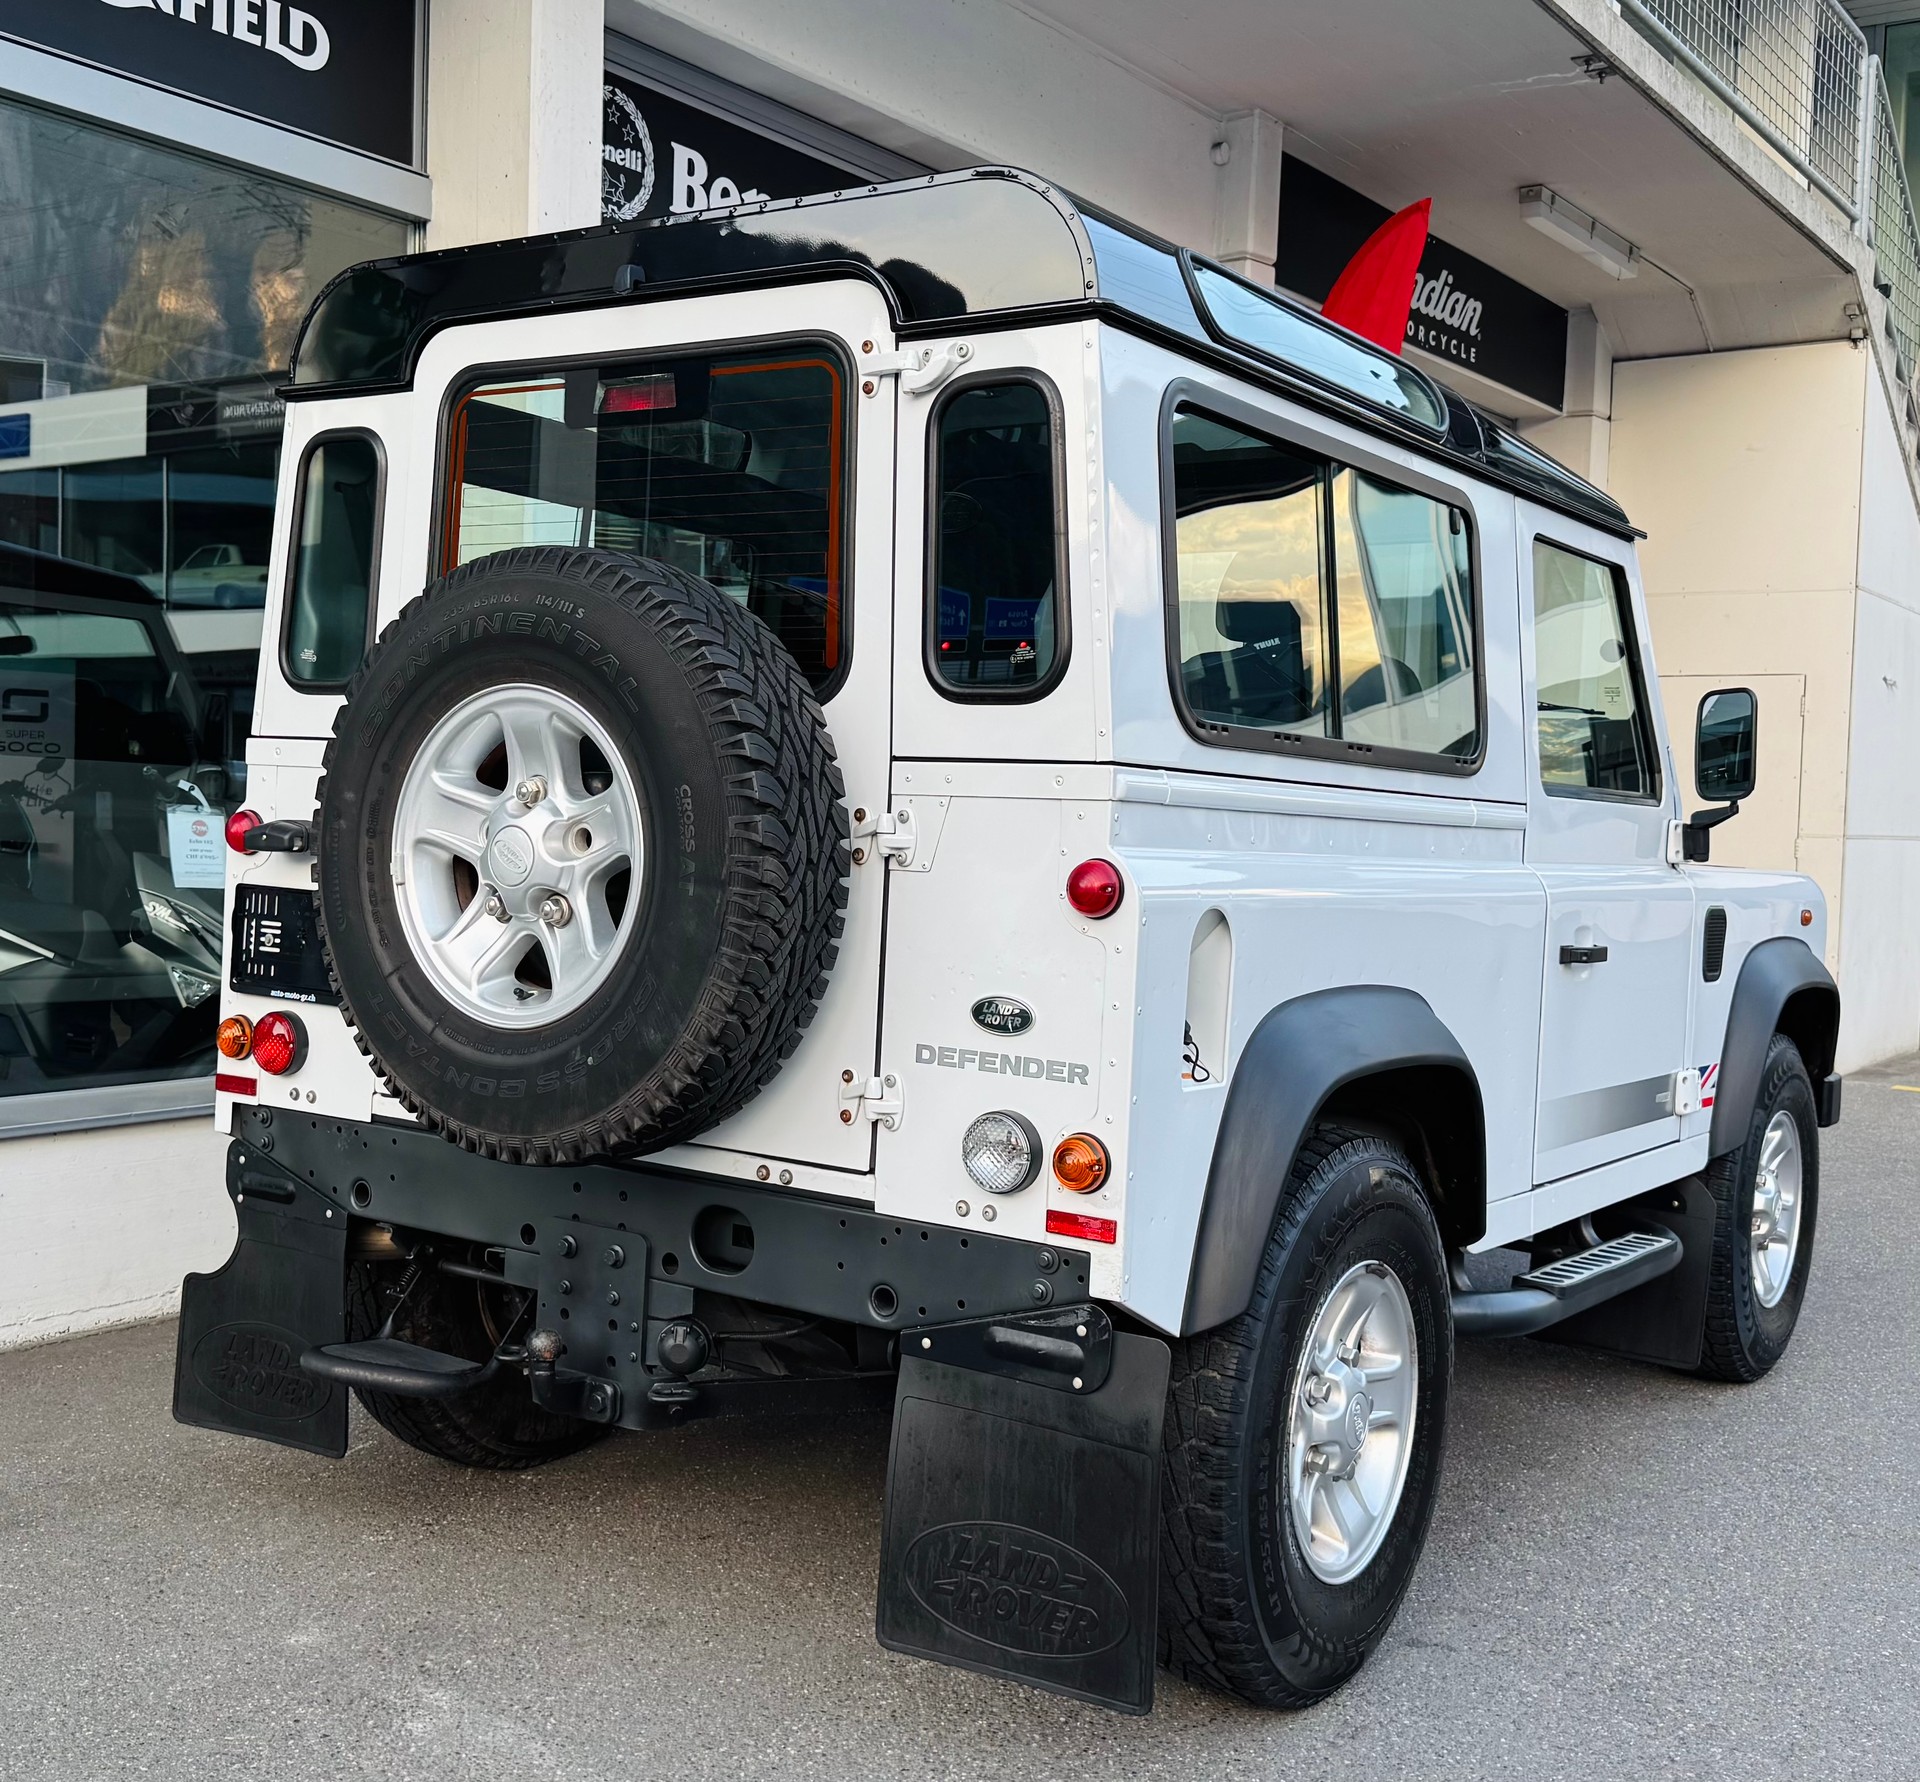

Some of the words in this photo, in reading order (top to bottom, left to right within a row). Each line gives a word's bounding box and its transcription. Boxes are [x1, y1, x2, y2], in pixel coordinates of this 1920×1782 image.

[100, 0, 330, 71] FIELD
[602, 144, 642, 174] nelli
[1253, 637, 1281, 650] THULE
[359, 611, 640, 747] CONTINENTAL
[5, 729, 46, 740] SUPER
[680, 784, 696, 853] CROSS
[144, 901, 173, 920] SYM
[982, 1001, 1013, 1016] LAND
[984, 1013, 1022, 1028] ROVER
[915, 1043, 1090, 1086] DEFENDER
[946, 1533, 1060, 1592] LAND
[954, 1576, 1100, 1645] ROVER
